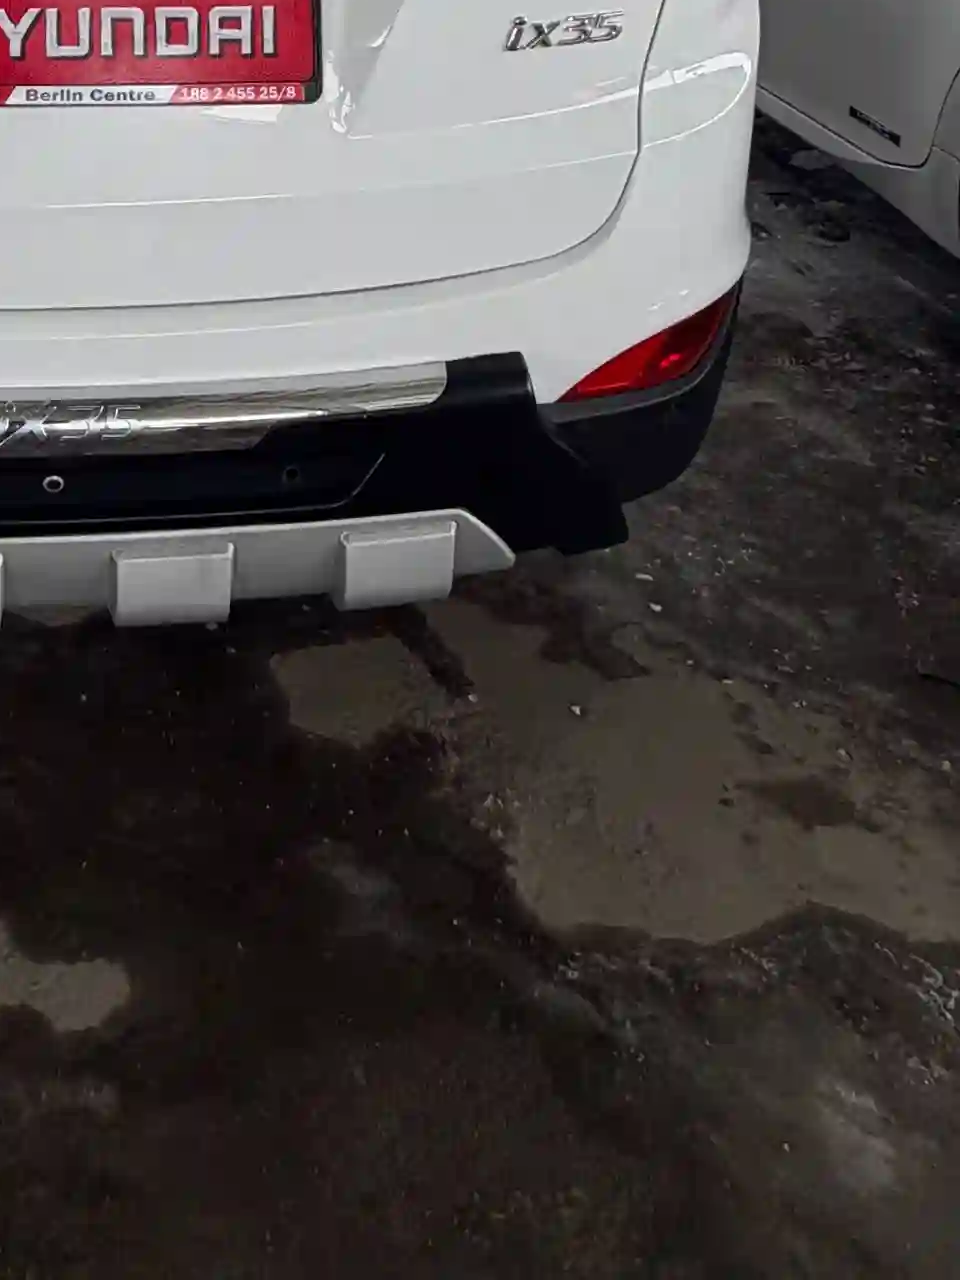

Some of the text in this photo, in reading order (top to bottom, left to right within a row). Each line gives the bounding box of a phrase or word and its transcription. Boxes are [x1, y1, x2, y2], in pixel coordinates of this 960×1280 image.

[503, 8, 625, 52] ix35
[25, 88, 84, 102] Berlin
[90, 88, 157, 102] Centre
[259, 85, 297, 101] 25/8
